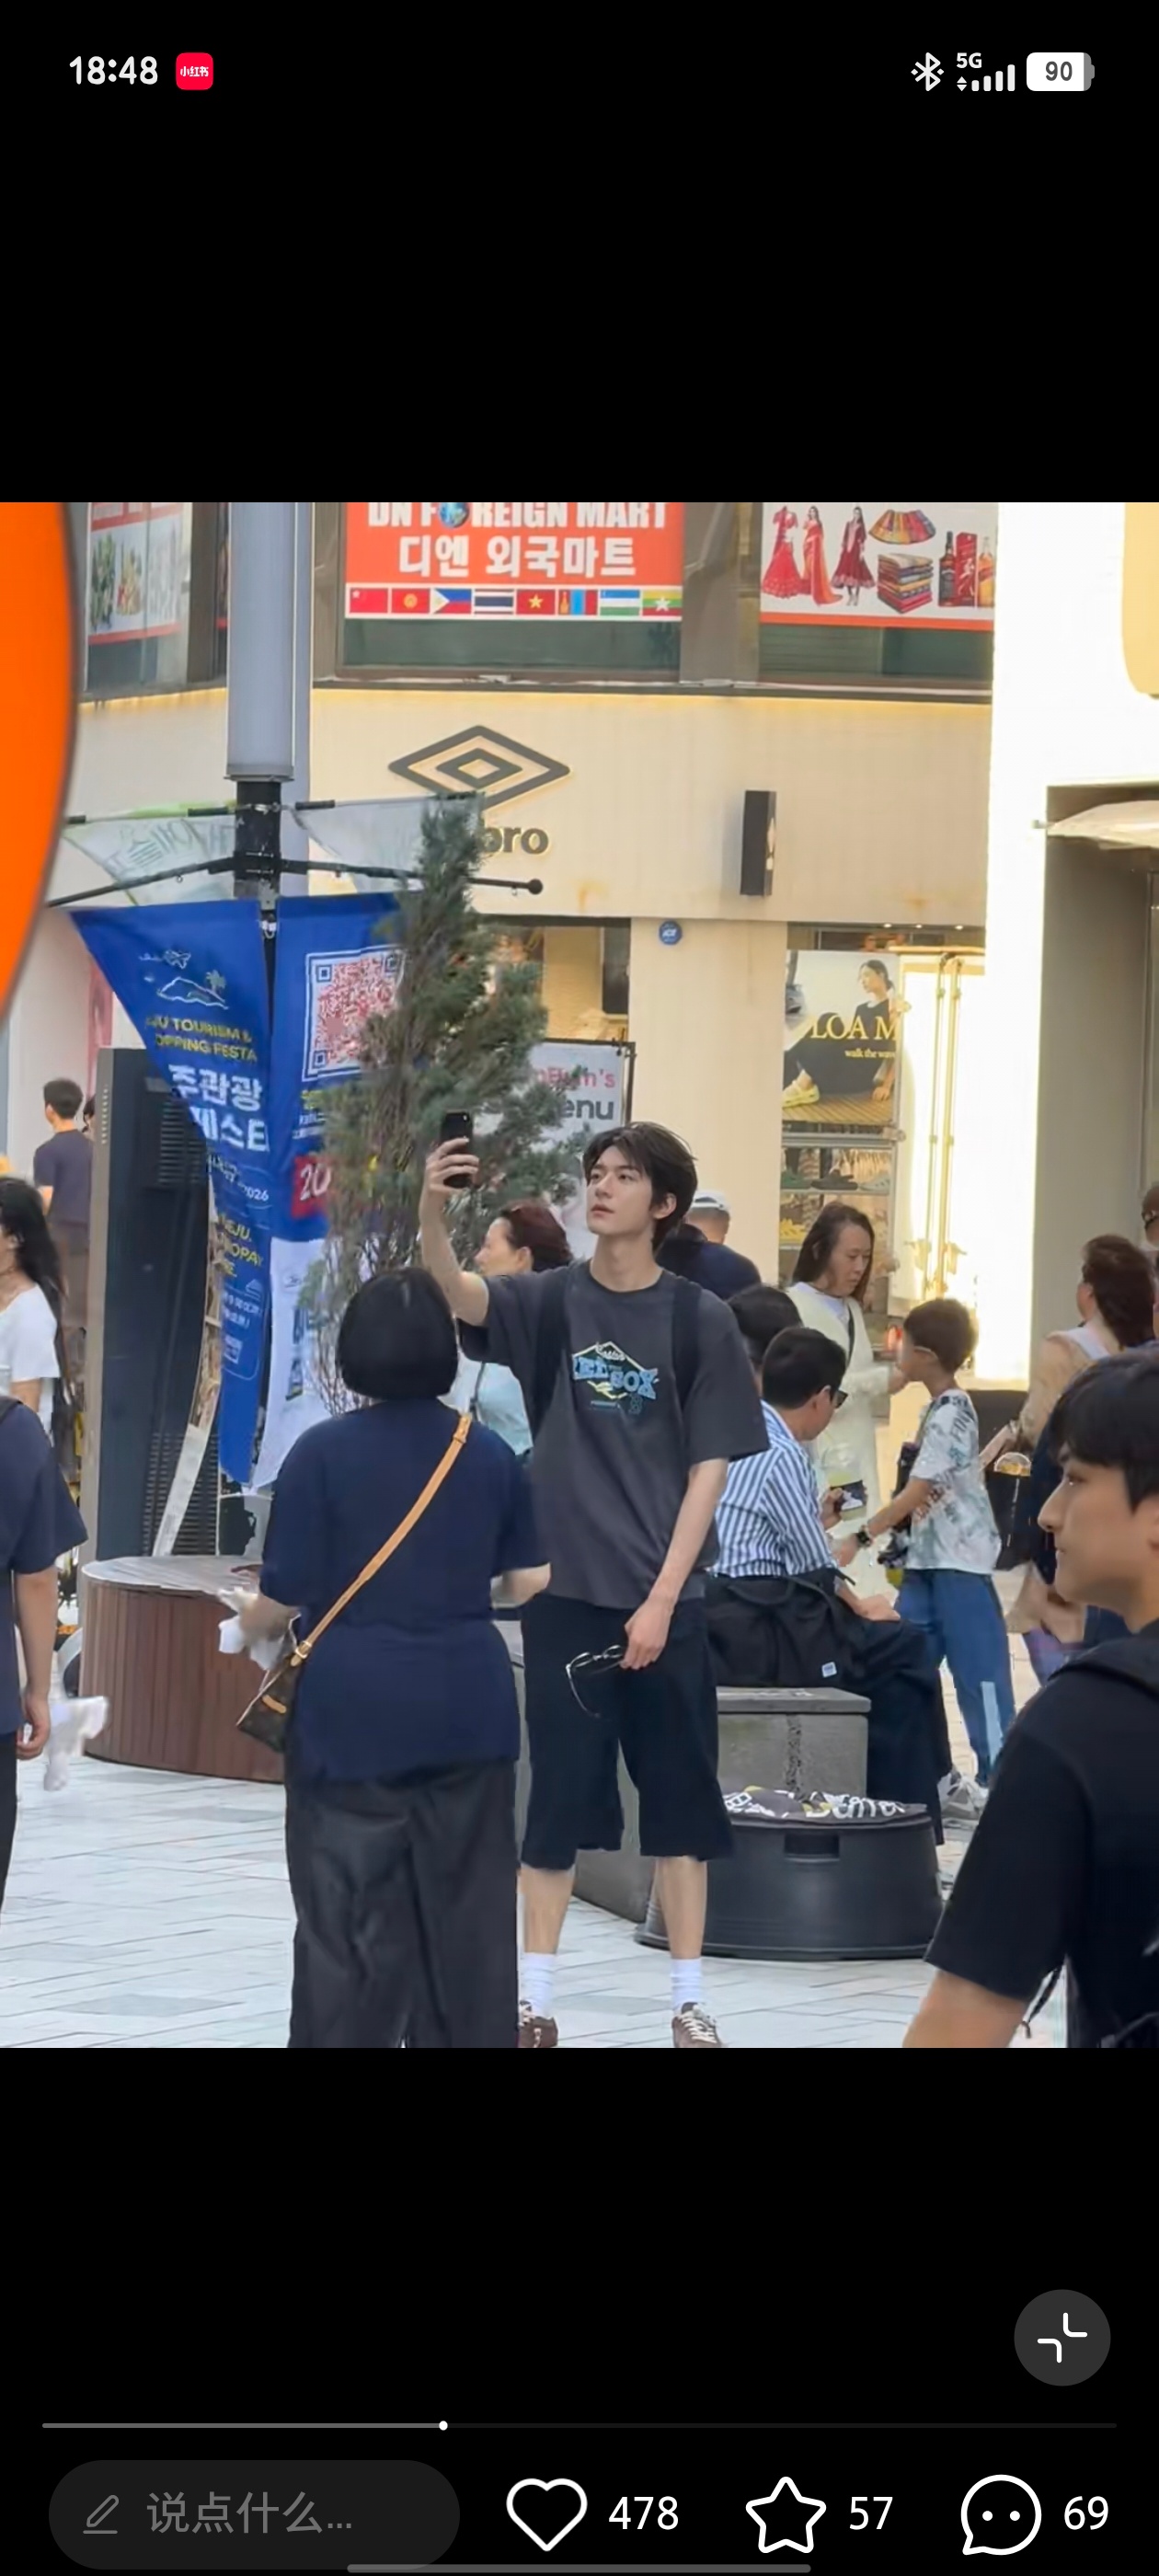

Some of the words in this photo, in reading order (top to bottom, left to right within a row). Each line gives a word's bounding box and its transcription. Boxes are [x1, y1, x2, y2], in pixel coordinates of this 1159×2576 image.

[399, 535, 469, 578] 디엔
[486, 535, 636, 579] 외국마트
[810, 1015, 868, 1040] LOA
[212, 1042, 258, 1063] FESTA
[168, 1064, 263, 1111] 주관광
[563, 1099, 614, 1120] enu
